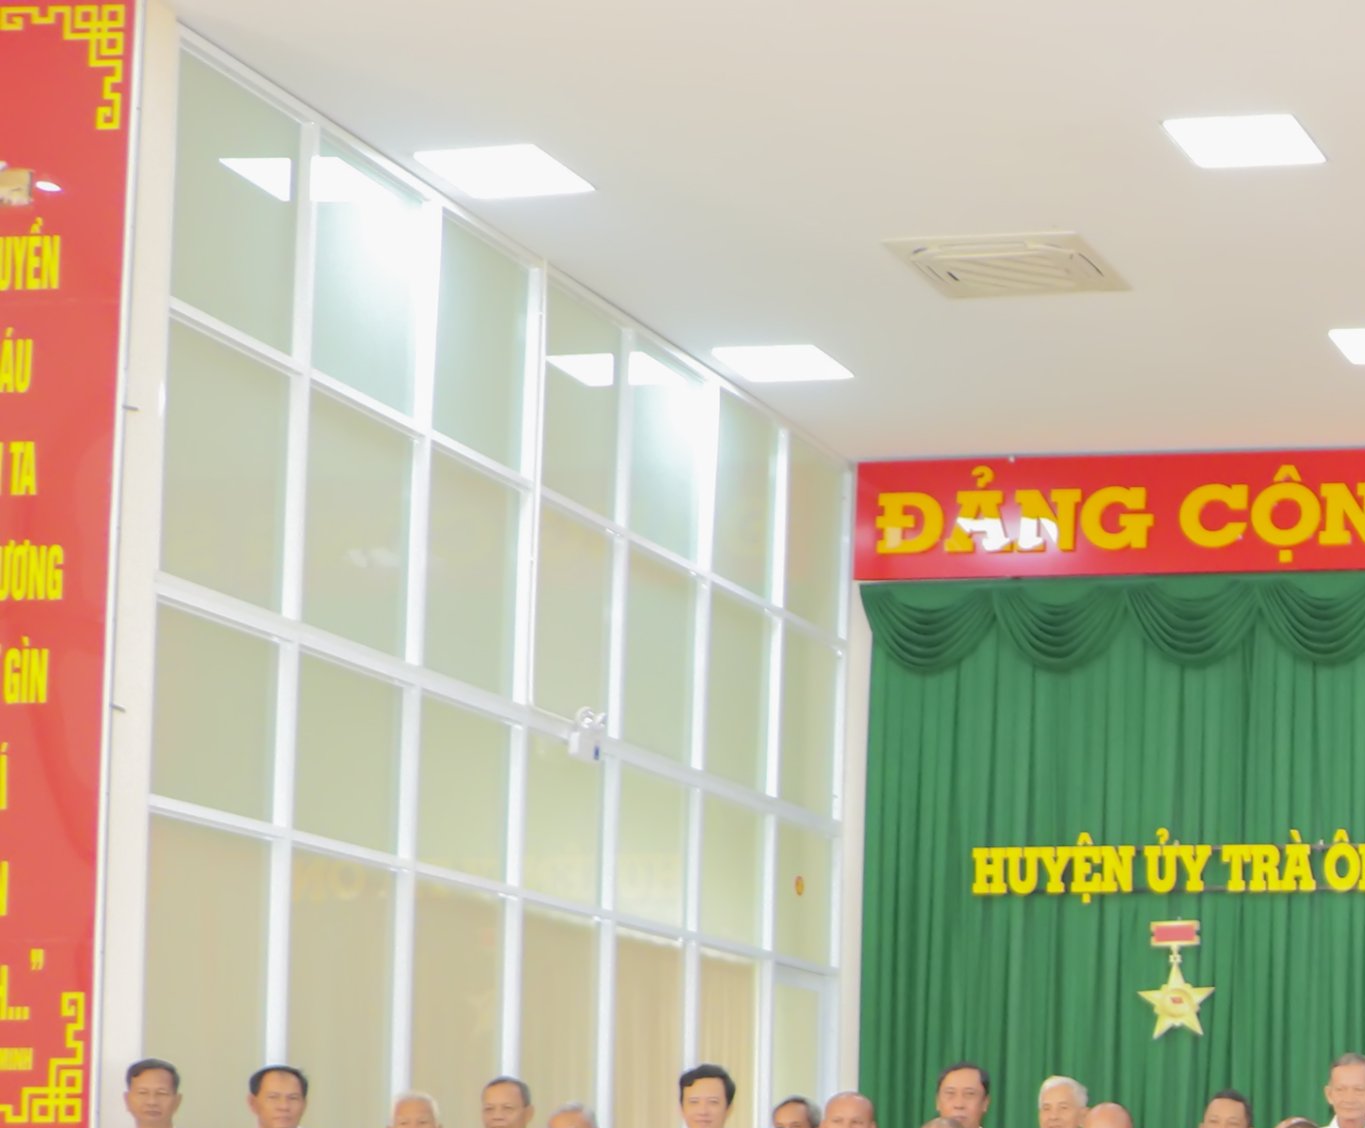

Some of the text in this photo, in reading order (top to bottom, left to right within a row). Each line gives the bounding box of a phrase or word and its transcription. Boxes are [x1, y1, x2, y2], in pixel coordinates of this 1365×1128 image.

[9, 441, 37, 496] TA
[876, 465, 1154, 554] ĐẢNG
[4, 636, 49, 704] GÌN
[973, 832, 1135, 903] HUYỆN
[1144, 828, 1212, 893] ỦY
[1222, 830, 1316, 892] TRÀ
